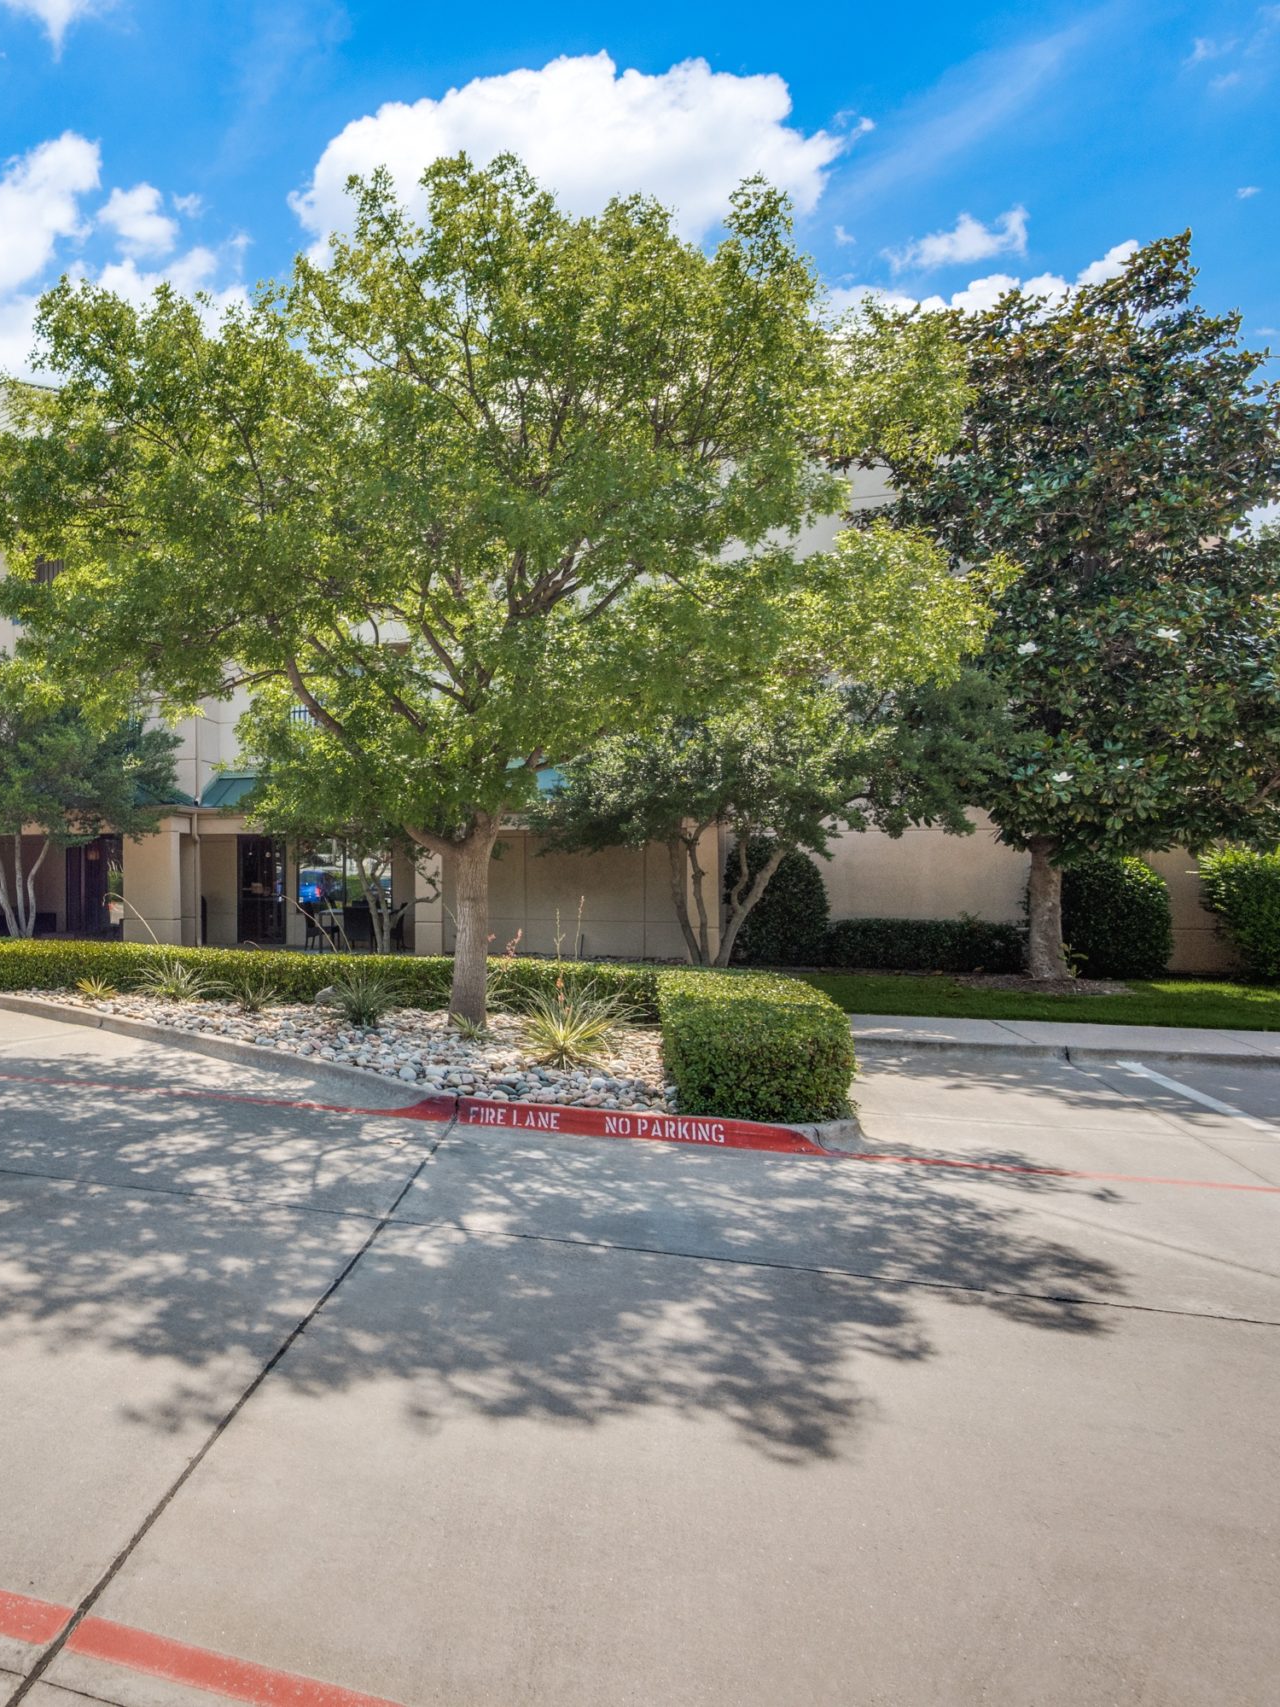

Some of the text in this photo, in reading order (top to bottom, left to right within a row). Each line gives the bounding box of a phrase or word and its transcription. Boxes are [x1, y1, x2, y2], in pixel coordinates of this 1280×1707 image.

[468, 1106, 725, 1143] FIRE LANE NO PARKING
